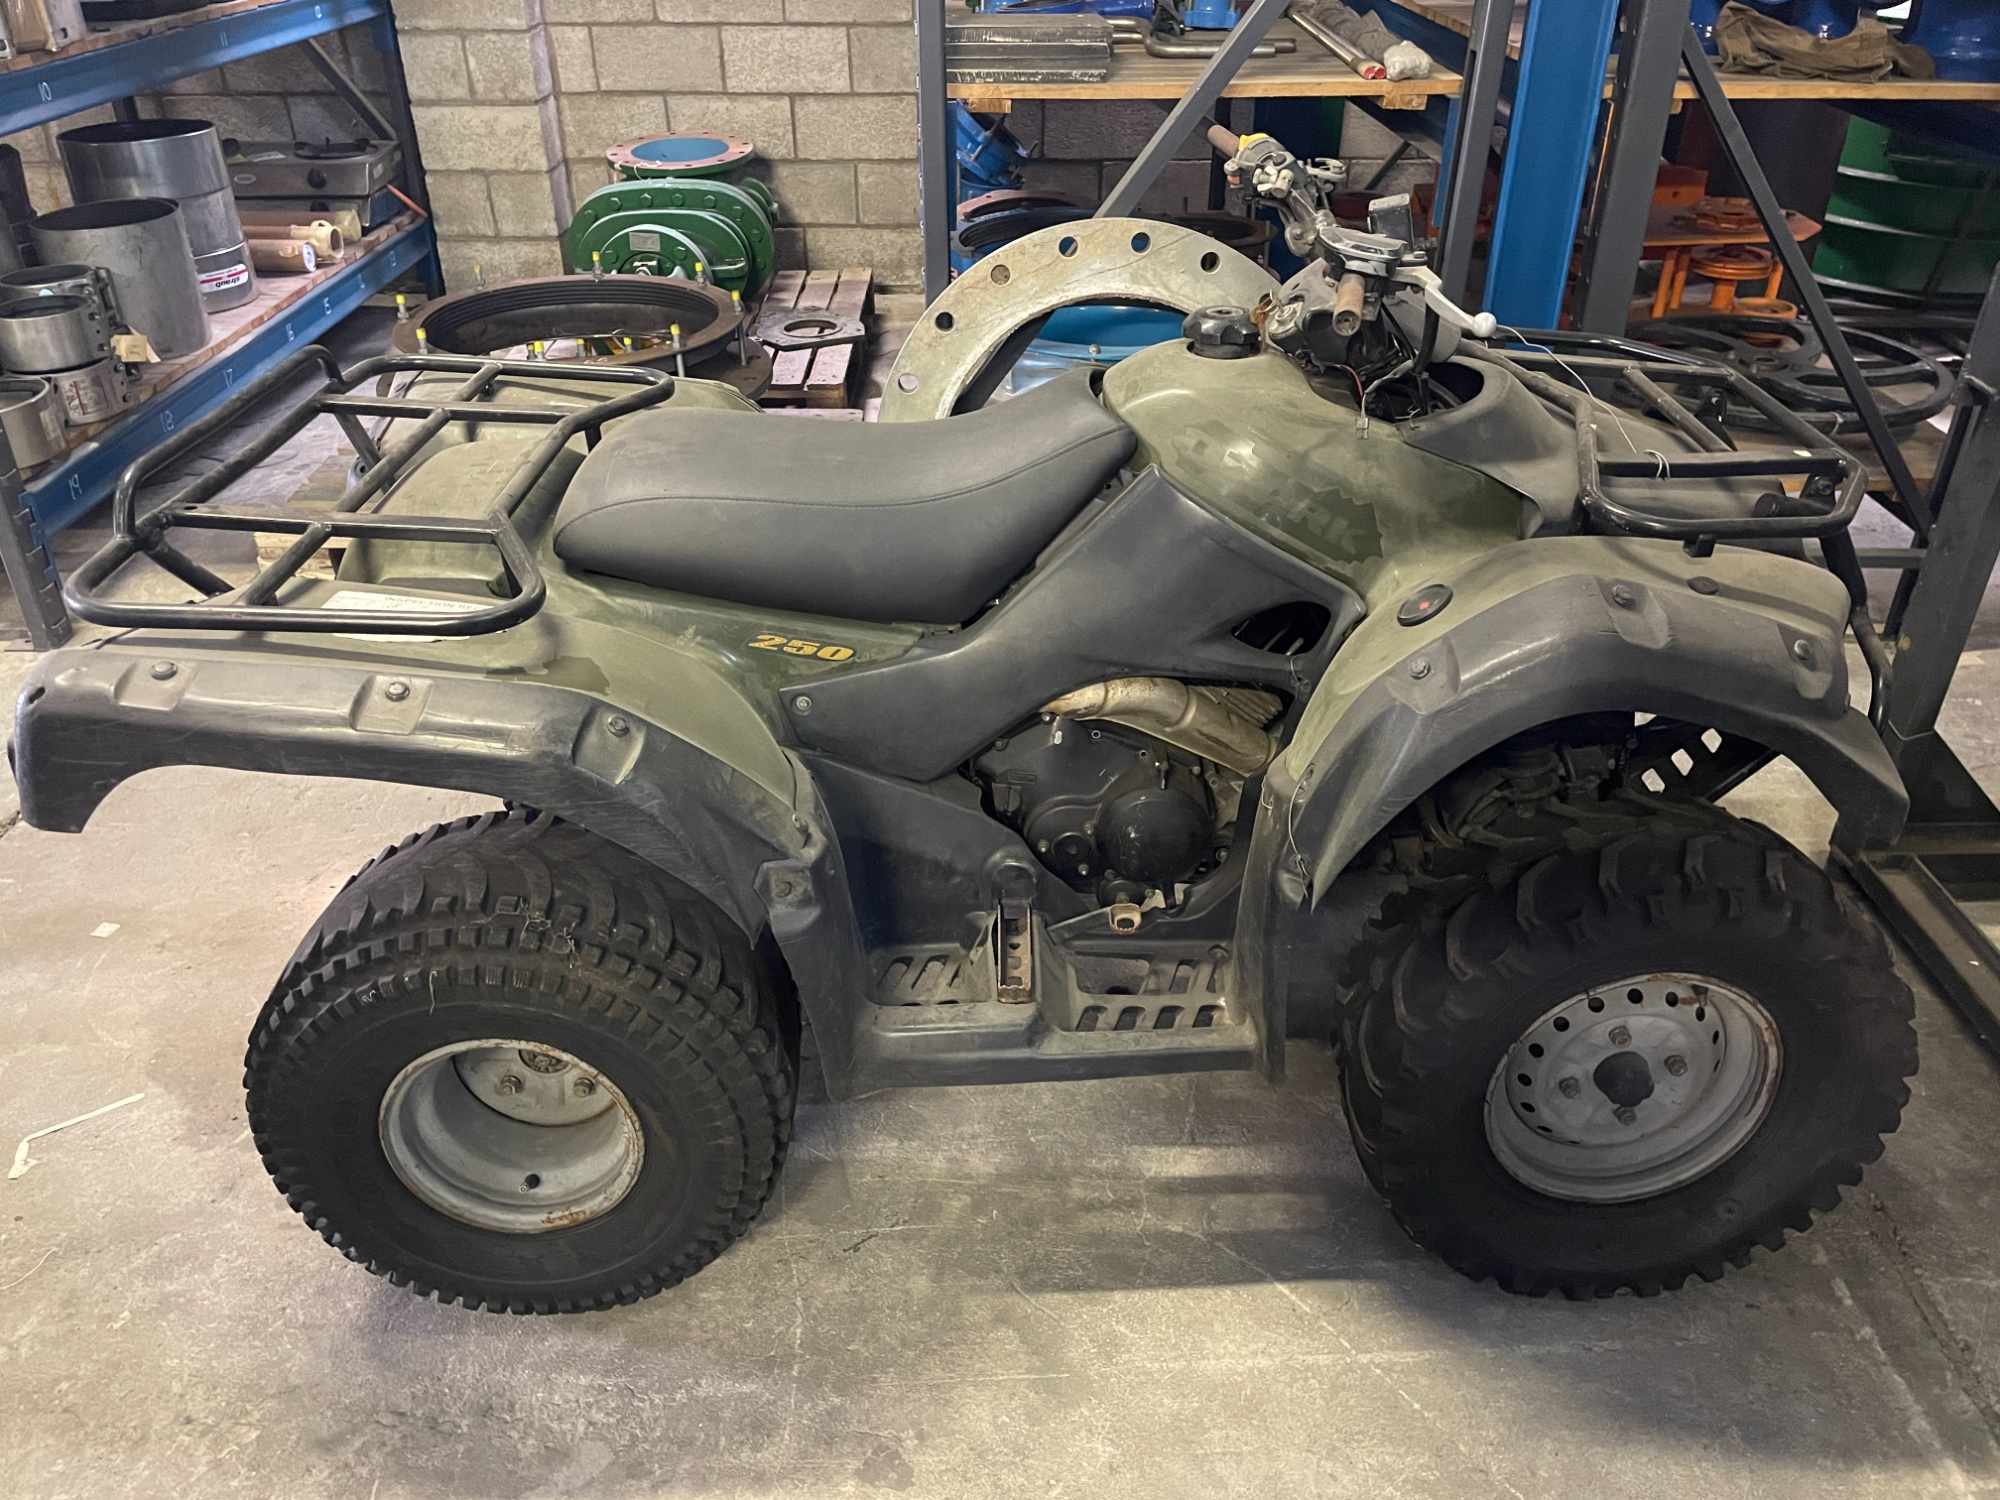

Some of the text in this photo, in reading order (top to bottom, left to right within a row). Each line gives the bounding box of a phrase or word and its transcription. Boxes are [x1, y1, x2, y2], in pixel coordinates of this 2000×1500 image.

[38, 81, 52, 101] 10
[68, 473, 83, 501] 19
[748, 634, 855, 661] 250
